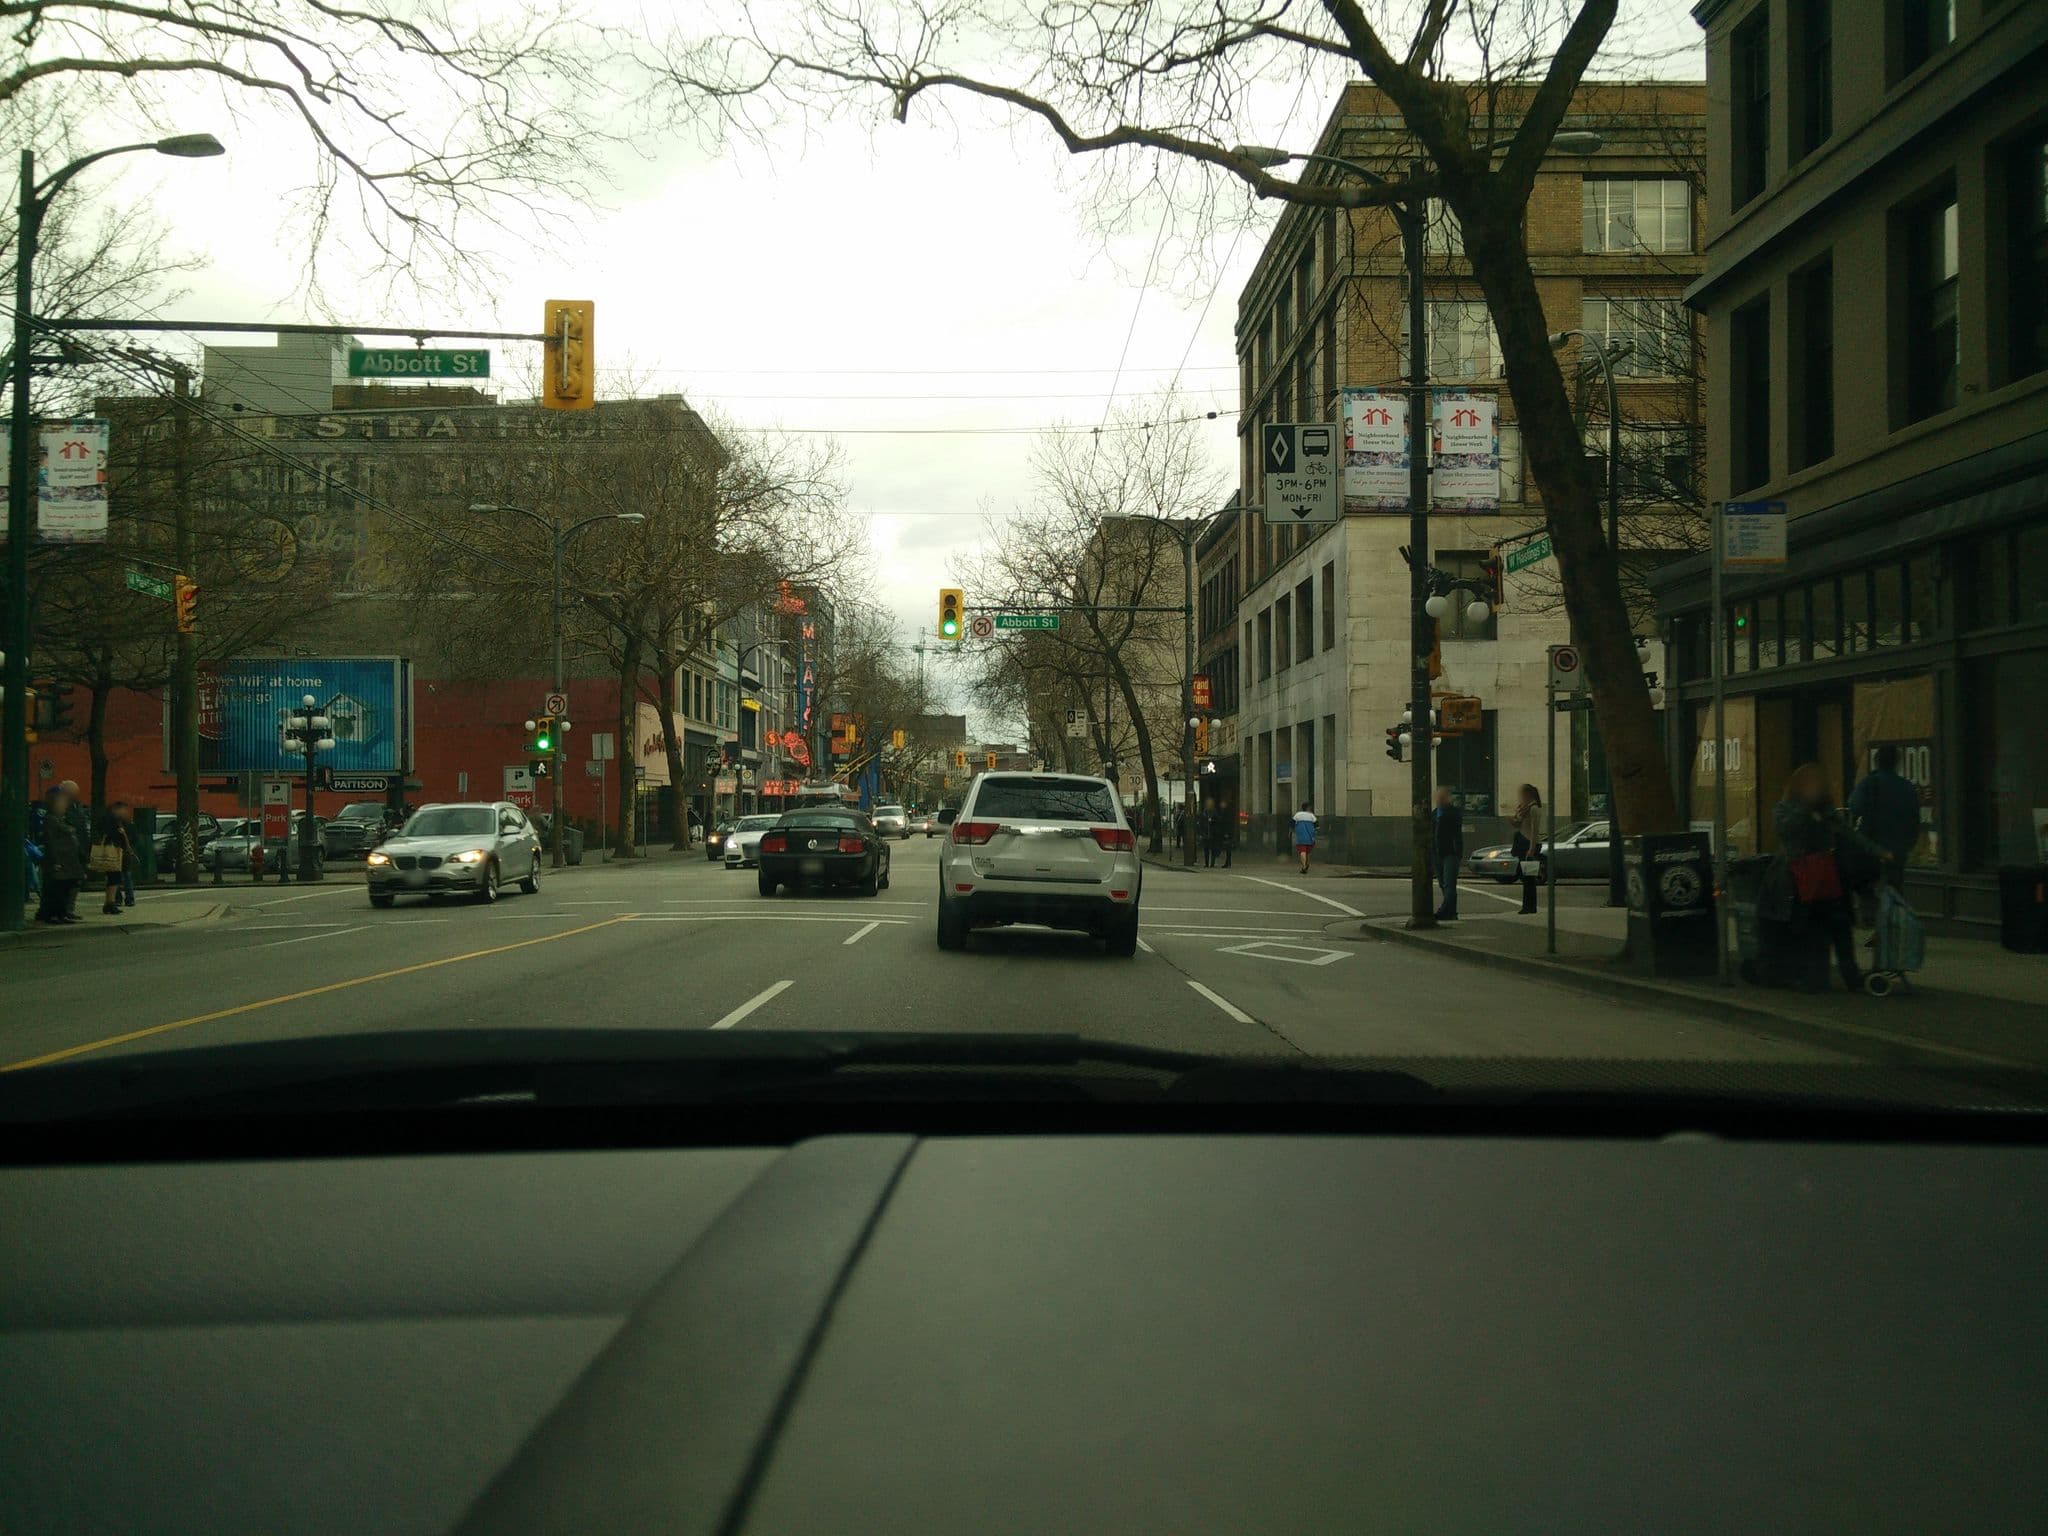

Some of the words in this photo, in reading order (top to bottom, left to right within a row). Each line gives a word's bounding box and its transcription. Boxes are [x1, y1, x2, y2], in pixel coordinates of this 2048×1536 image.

[360, 353, 442, 373] Abbott
[452, 353, 479, 373] St
[1281, 494, 1322, 503] MON-FRI
[1508, 554, 1515, 569] W
[1516, 545, 1541, 566] Hastings
[1541, 539, 1549, 554] St
[1001, 617, 1037, 628] Abbott
[1041, 618, 1054, 628] St
[269, 676, 283, 688] at
[286, 675, 323, 688] home
[1193, 680, 1209, 690] rand
[1193, 692, 1209, 705] nion
[1701, 738, 1741, 773] PRDO
[1870, 745, 1931, 787] PDO
[334, 780, 384, 790] PATTISON
[507, 794, 532, 805] Park
[265, 814, 288, 823] Park
